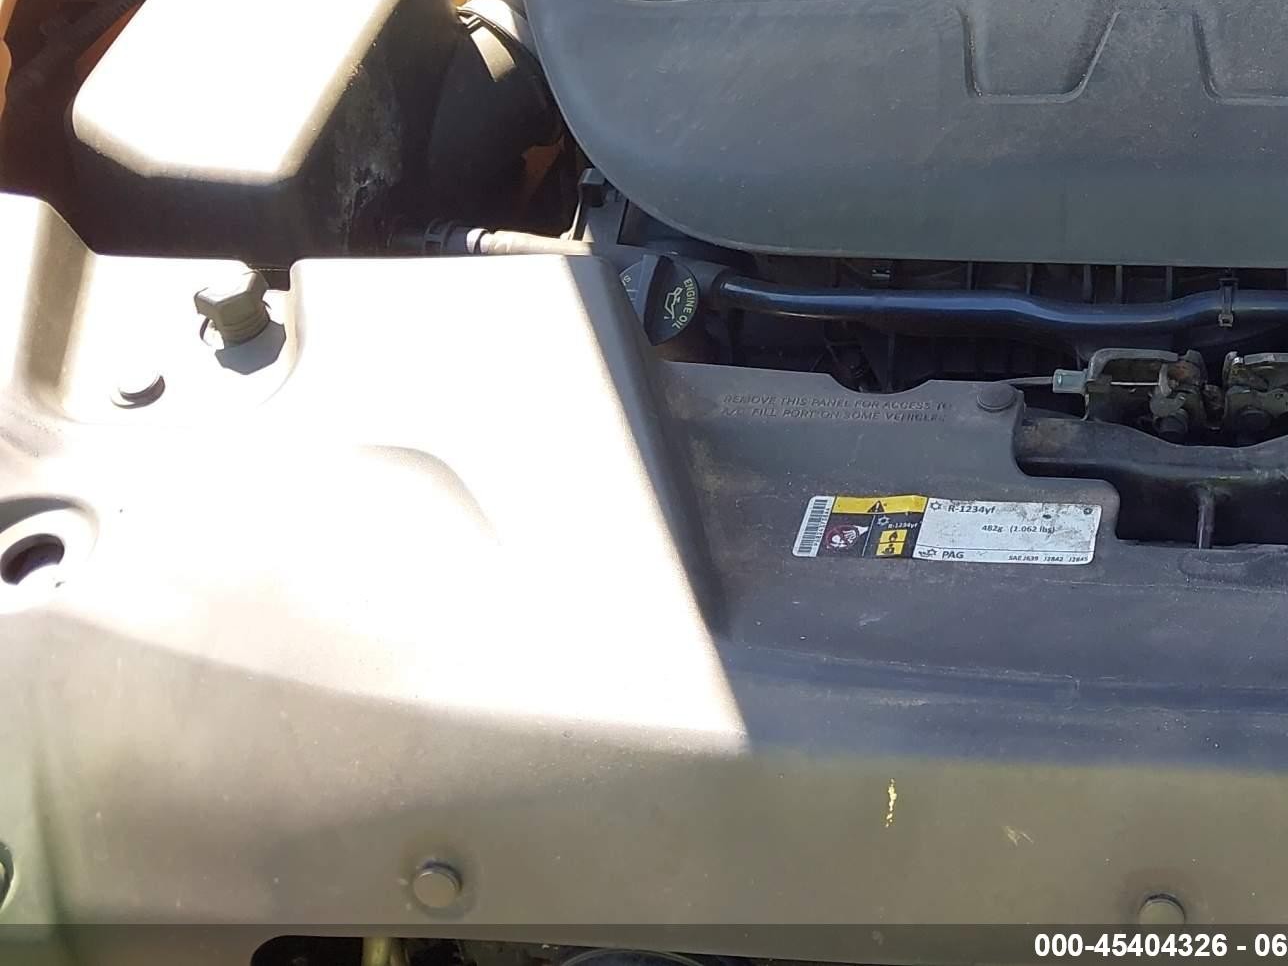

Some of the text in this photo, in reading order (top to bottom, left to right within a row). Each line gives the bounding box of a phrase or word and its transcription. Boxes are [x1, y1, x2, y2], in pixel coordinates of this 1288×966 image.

[671, 277, 695, 329] ENGINE OIL
[723, 395, 777, 404] REMOVE
[781, 396, 807, 406] THIS
[811, 398, 848, 408] PANEL
[855, 400, 880, 409] FOR
[882, 401, 931, 410] ACCESS
[752, 408, 777, 416] FILL
[783, 409, 815, 418] PORT
[821, 410, 841, 419] ON
[844, 411, 881, 420] SOME
[948, 505, 996, 514] R-1234yf
[942, 550, 965, 559] PAG
